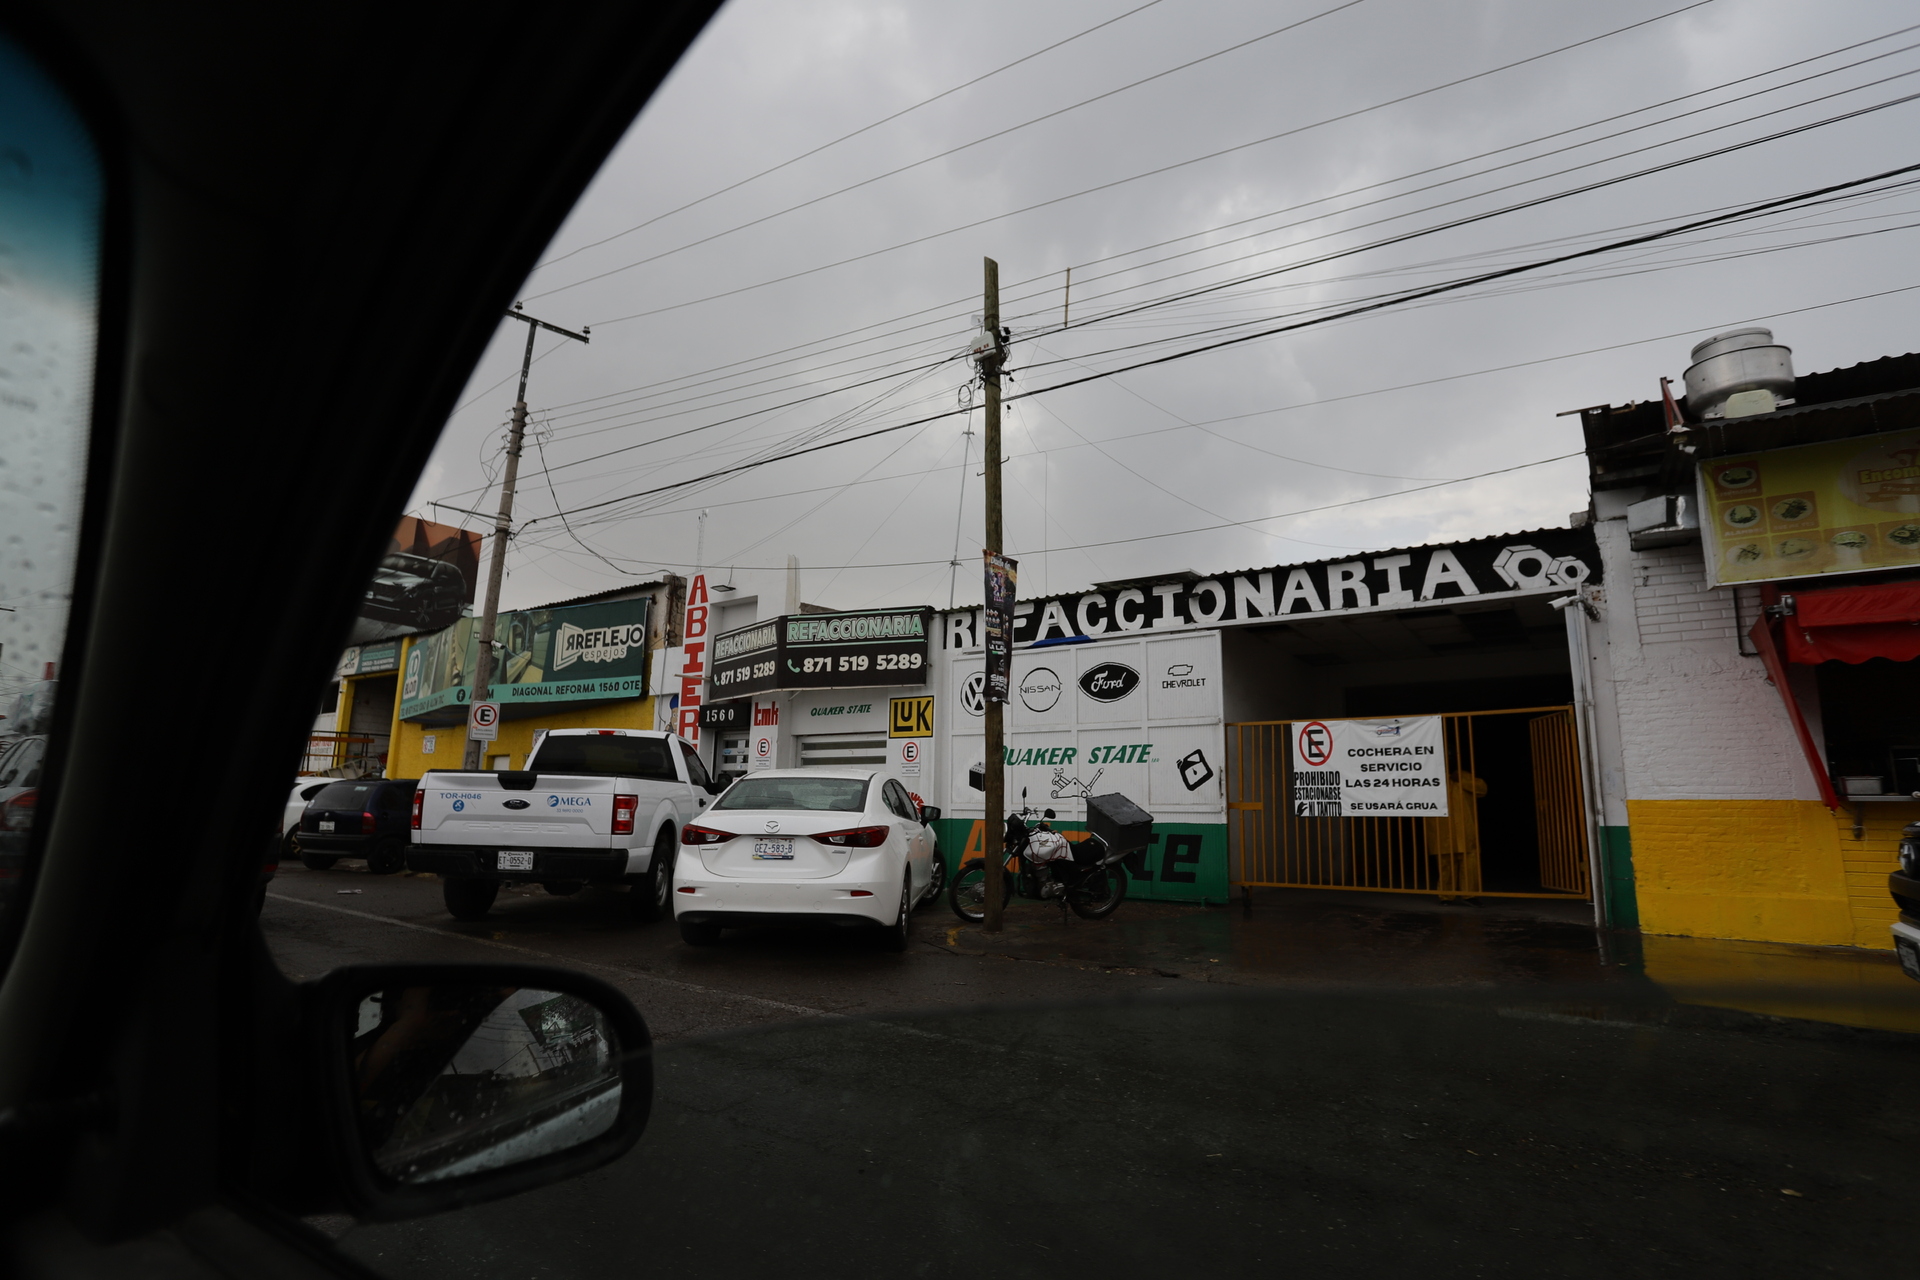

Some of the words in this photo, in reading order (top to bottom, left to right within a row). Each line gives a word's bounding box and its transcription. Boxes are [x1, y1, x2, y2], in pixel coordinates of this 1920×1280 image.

[787, 613, 925, 642] REFACCIONARIA
[715, 624, 778, 660] REFACCIONARIA
[585, 647, 625, 660] espejos
[803, 657, 832, 673] 871
[839, 655, 869, 672] 519
[876, 653, 922, 670] 5289
[720, 670, 734, 686] 871
[736, 666, 751, 683] 519
[753, 660, 776, 679] 5289
[1091, 670, 1127, 692] Ford
[1162, 678, 1206, 689] CHEVROLET
[512, 685, 553, 697] DIAGONAL
[556, 683, 595, 695] REFORMA
[599, 681, 620, 692] 1560
[1020, 685, 1061, 694] NISSAN
[480, 709, 491, 722] E
[705, 708, 735, 723] 1560
[810, 705, 844, 717] QUAKER
[846, 704, 872, 715] STATE
[760, 742, 766, 753] E
[1307, 729, 1324, 758] E
[907, 745, 914, 758] E
[1088, 744, 1153, 764] STATE
[1347, 747, 1413, 757] COCHERA
[1415, 746, 1434, 755] EN
[1360, 762, 1422, 772] SERVICIO
[1294, 771, 1341, 786] PROHIBIDO
[1345, 779, 1371, 788] LAS
[1373, 778, 1389, 788] 24
[1392, 777, 1440, 787] HORAS
[440, 792, 482, 800] TOR-H046
[1294, 787, 1341, 801] ESTACIONARSE
[559, 796, 591, 806] MEGA
[1350, 802, 1364, 810] SE
[1406, 802, 1438, 810] GRUA
[1308, 802, 1316, 816] NI
[1317, 801, 1342, 817] TANTITO
